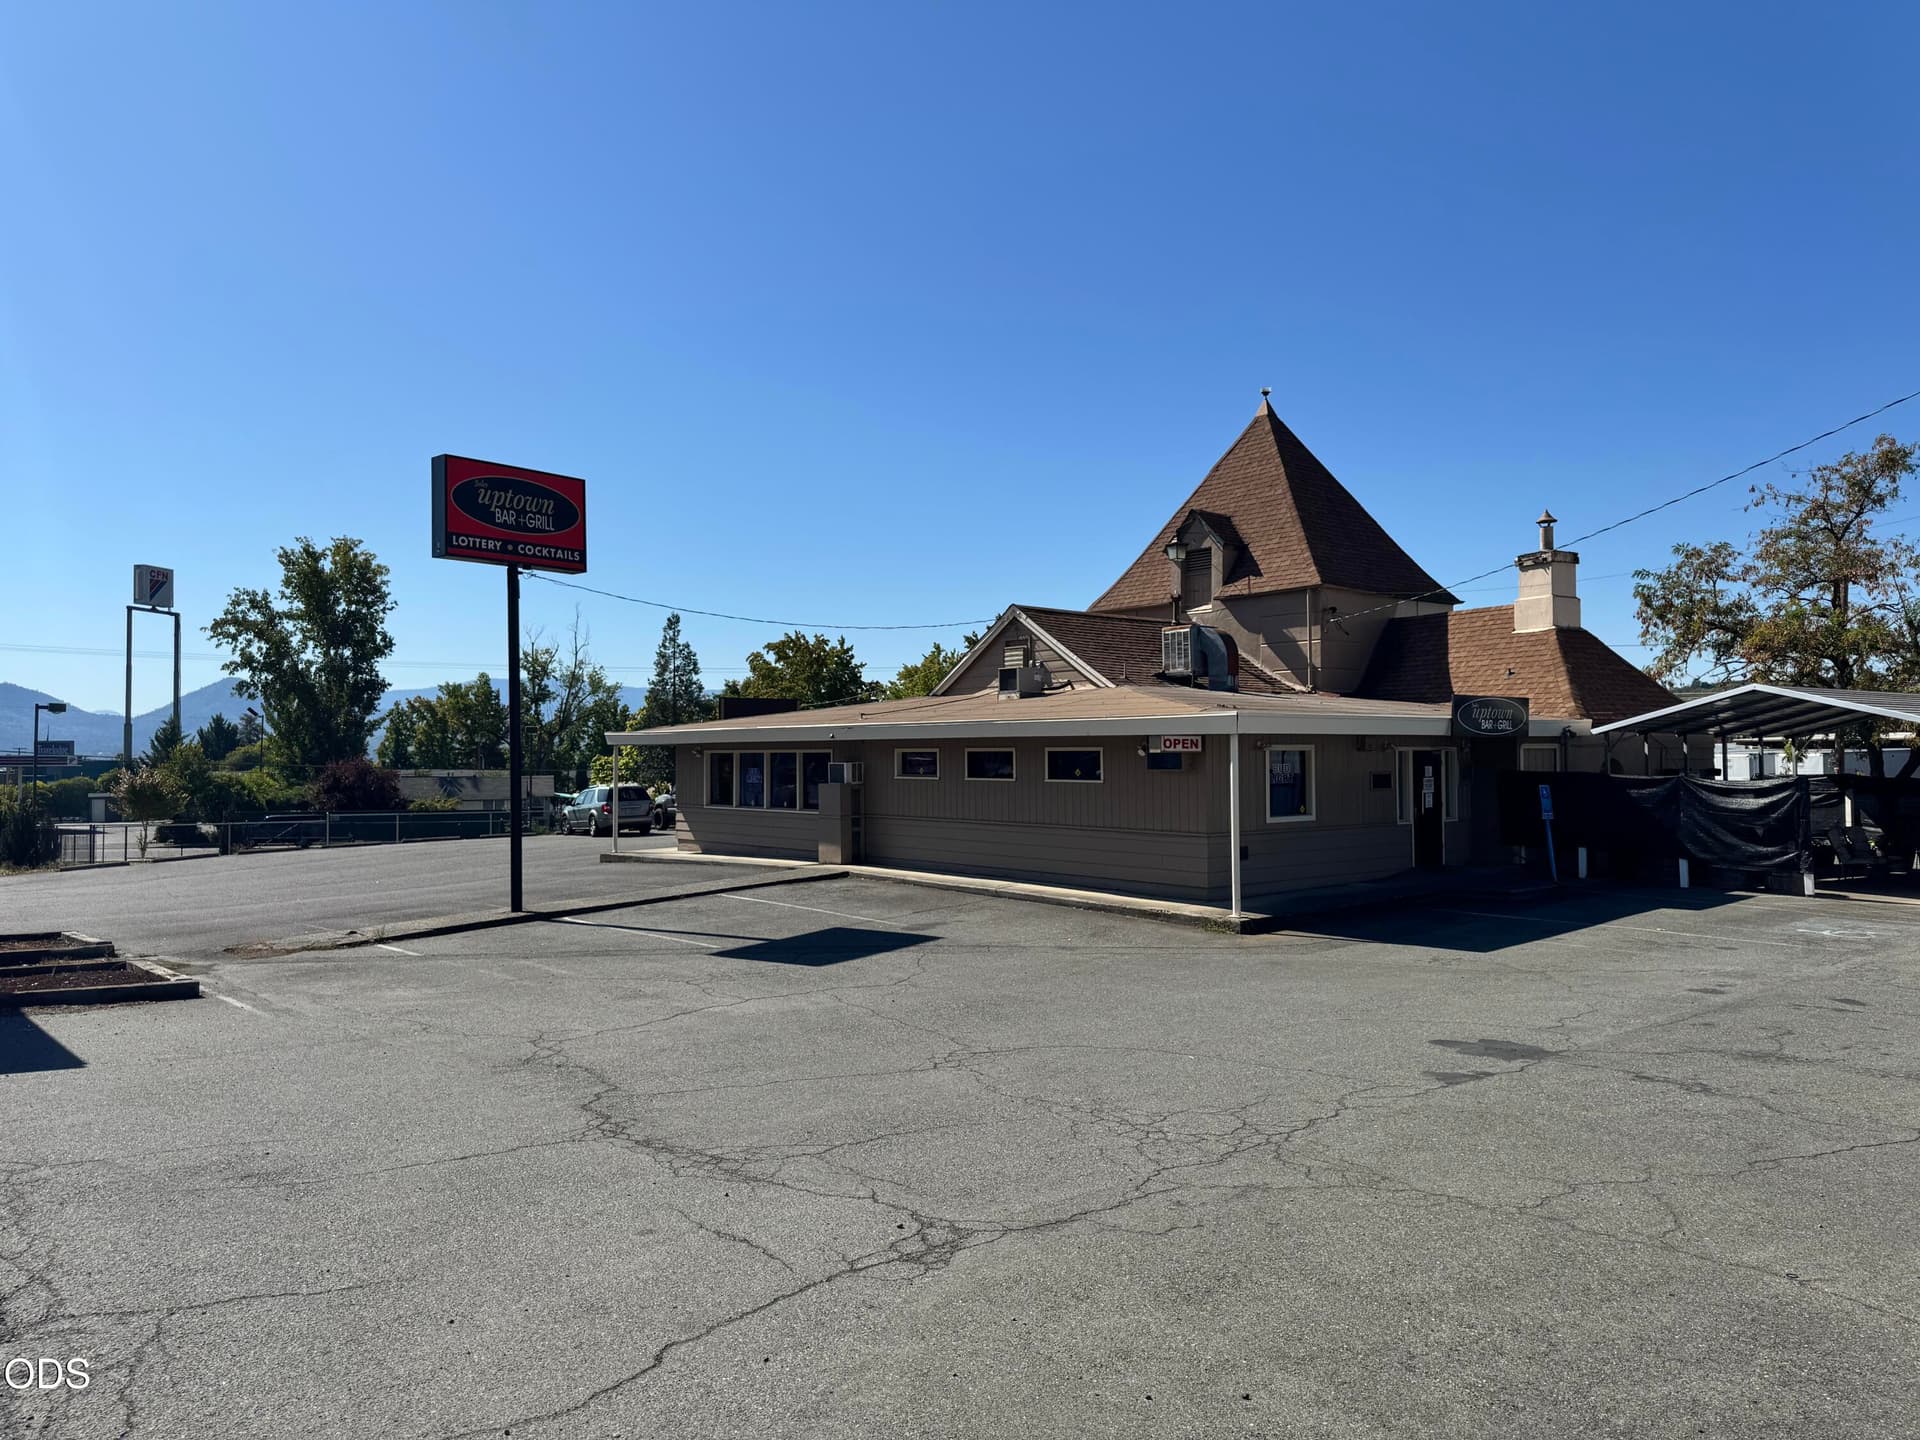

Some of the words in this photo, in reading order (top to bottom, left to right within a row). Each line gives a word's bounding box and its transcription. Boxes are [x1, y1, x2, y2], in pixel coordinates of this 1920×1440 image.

[477, 488, 555, 515] uptown
[452, 535, 503, 551] LOTTERY
[517, 544, 580, 561] COCKTAILS
[1472, 706, 1513, 723] uptown
[1163, 738, 1199, 749] OPEN
